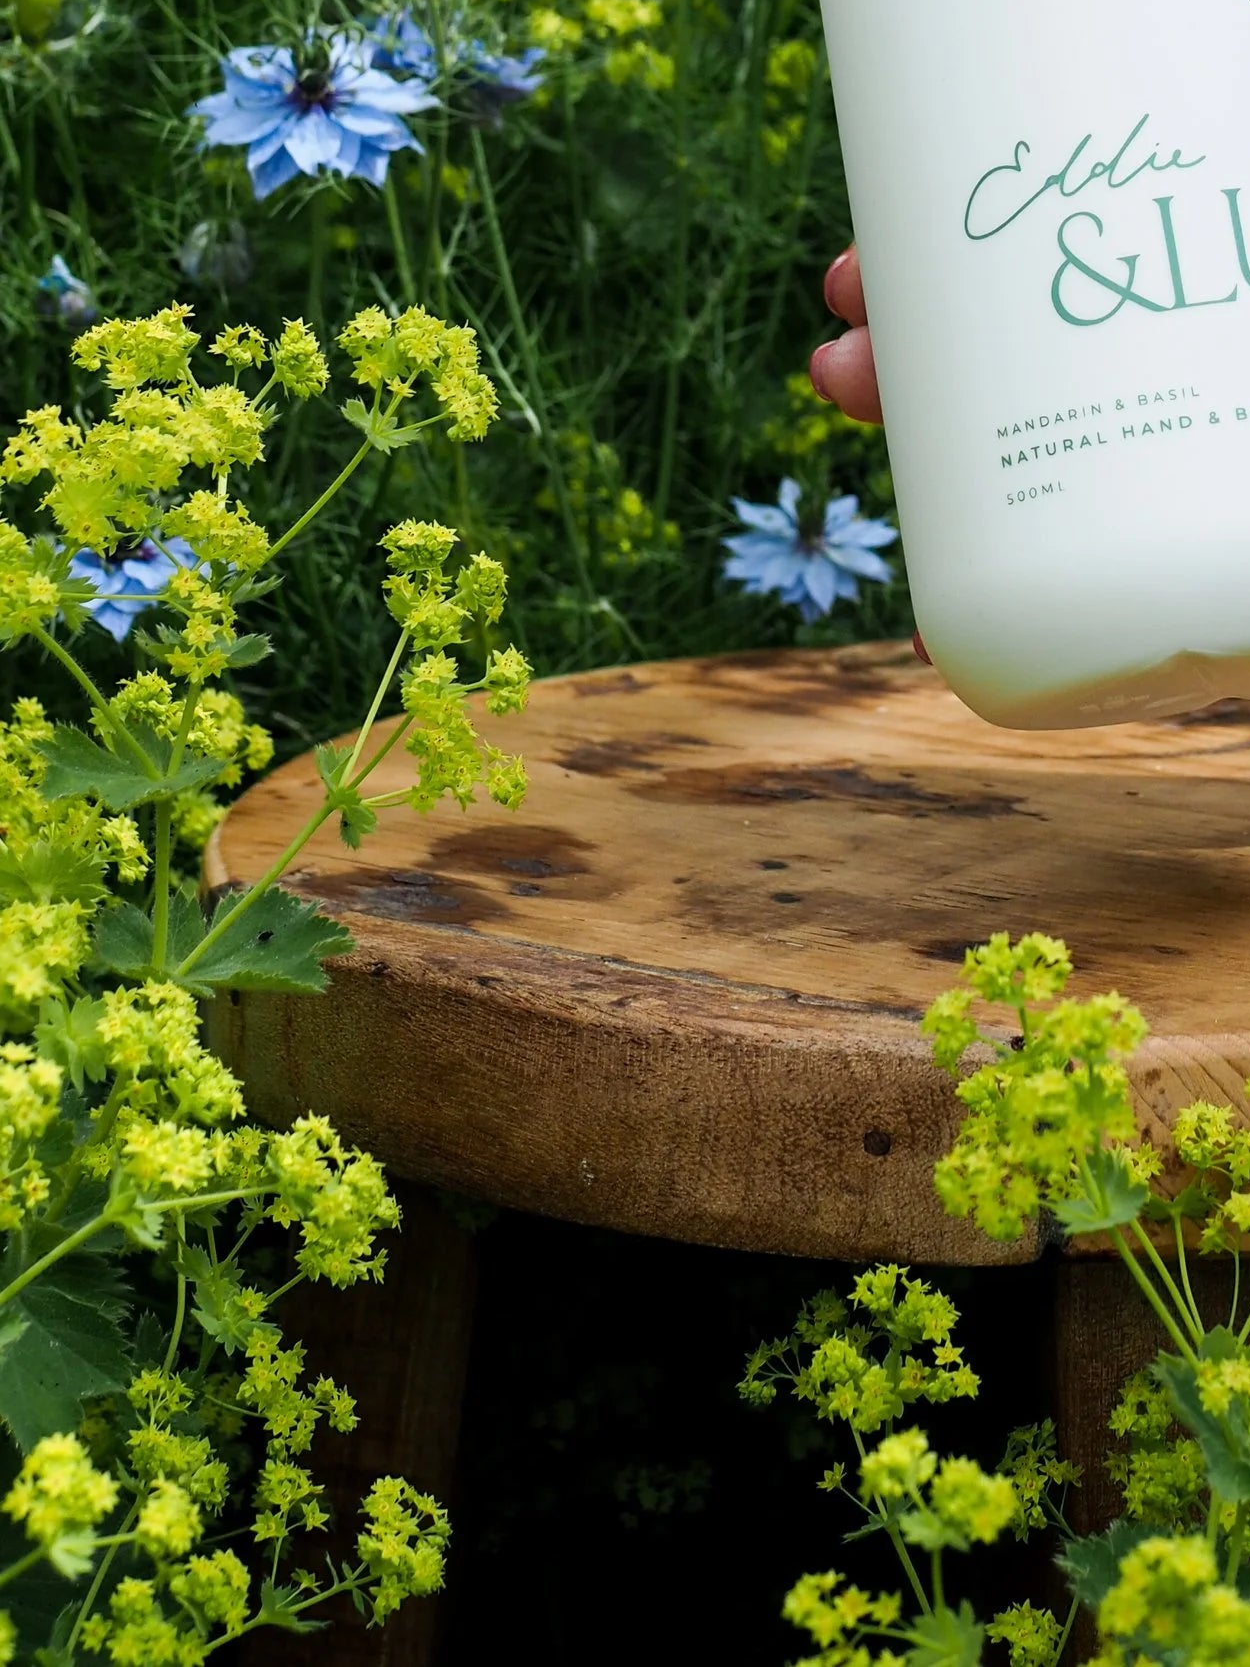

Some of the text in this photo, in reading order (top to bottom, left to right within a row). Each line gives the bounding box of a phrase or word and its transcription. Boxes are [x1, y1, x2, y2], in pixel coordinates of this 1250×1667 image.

[963, 112, 1207, 241] Eddie
[996, 386, 1201, 440] MANDARIN & BASIL
[1000, 431, 1108, 469] NATURAL
[1121, 415, 1193, 440] HAND
[1208, 410, 1221, 425] &
[1006, 480, 1066, 506] 500ML
